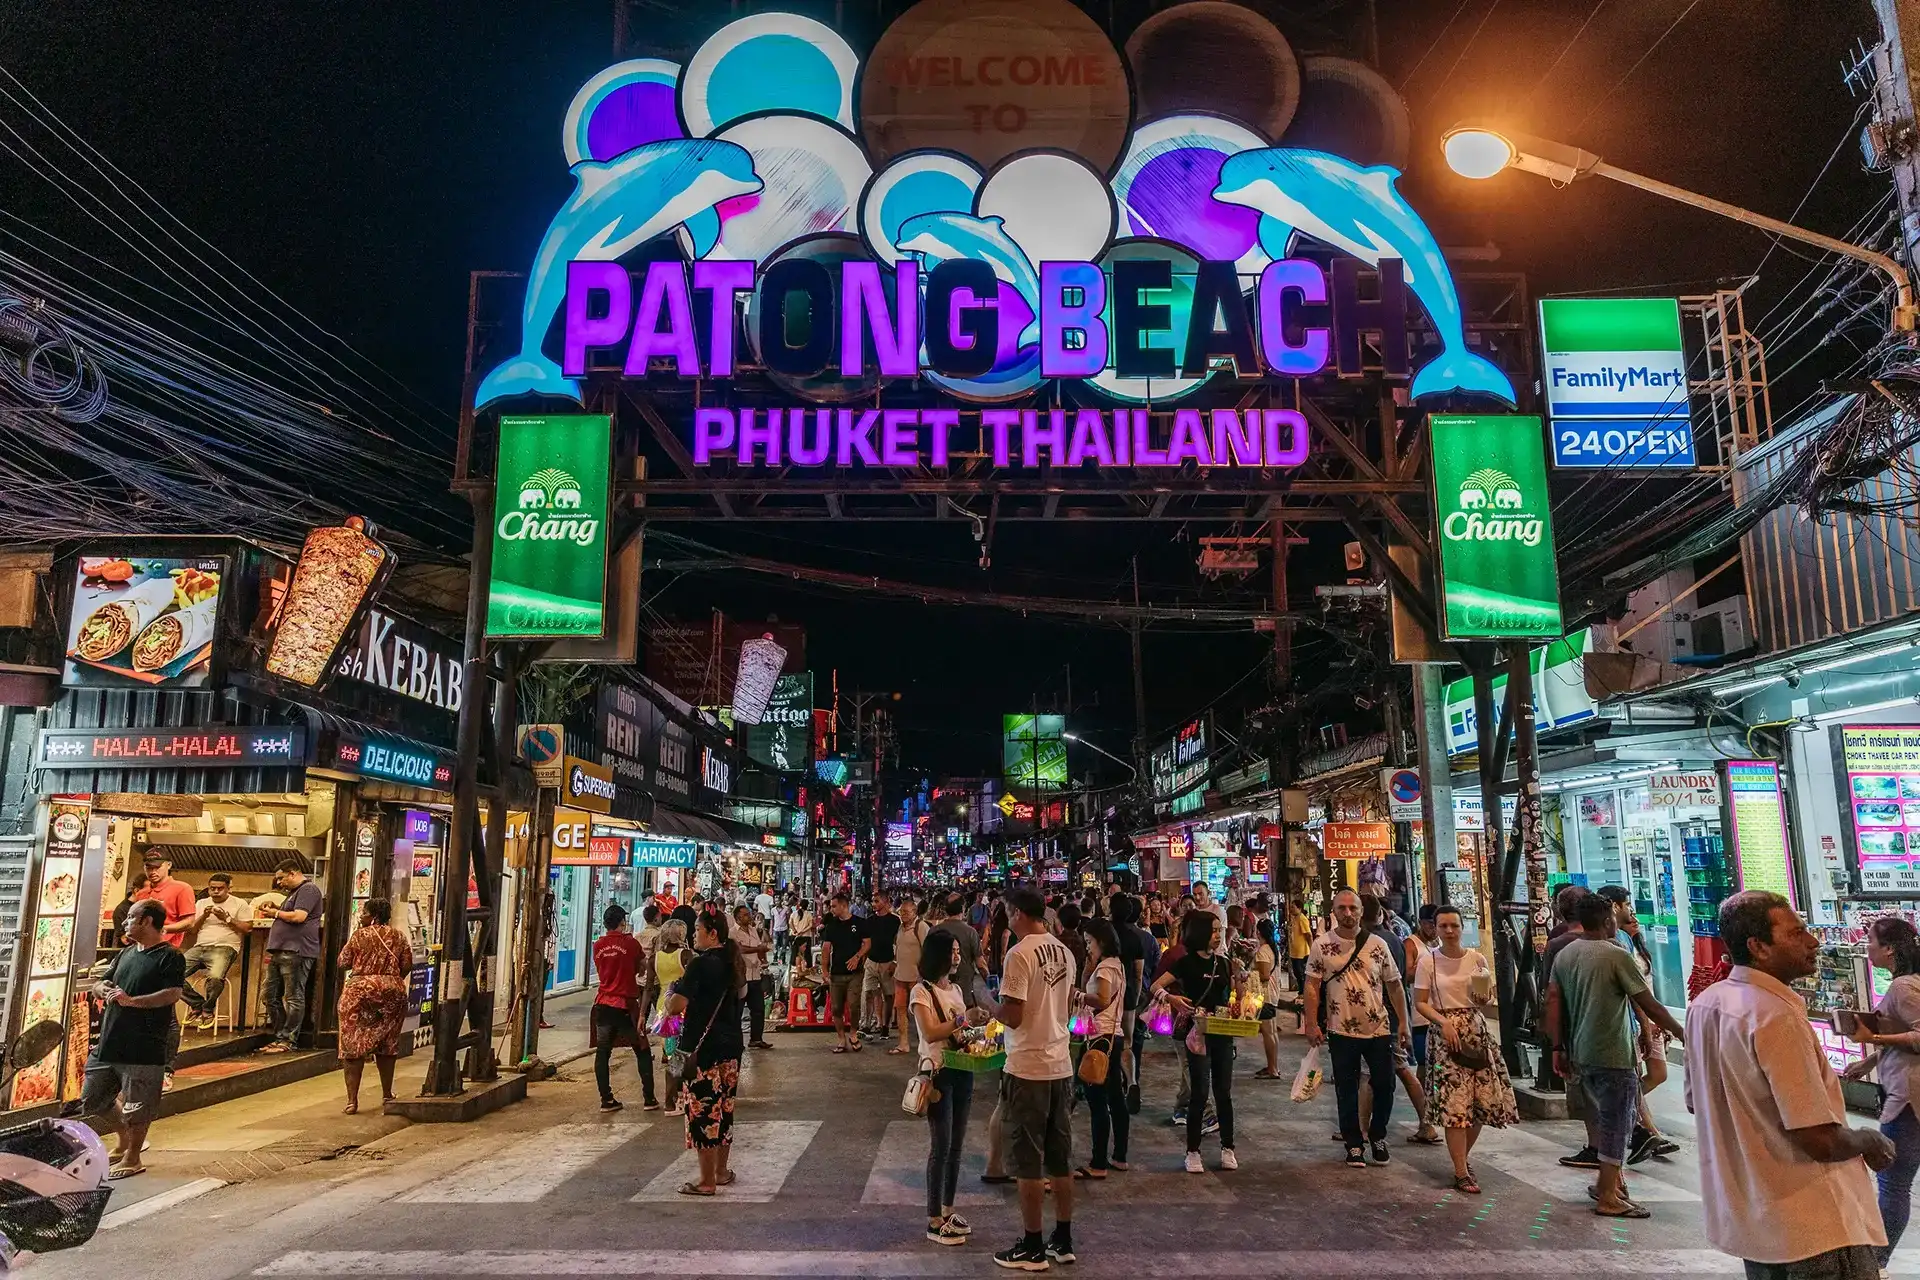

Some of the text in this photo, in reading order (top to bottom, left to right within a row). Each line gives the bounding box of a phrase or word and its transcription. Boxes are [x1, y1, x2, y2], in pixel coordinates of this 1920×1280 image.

[884, 56, 1105, 87] WELCOME
[964, 103, 1028, 134] TO
[562, 258, 1410, 380] PATONG BEACH
[1552, 366, 1683, 392] FamilyMart
[694, 408, 1311, 468] PHUKET THAILAND
[498, 511, 599, 547] Chang
[1444, 511, 1544, 547] Chang
[364, 610, 463, 712] KEBAB
[92, 736, 242, 757] HALAL-HALAL
[606, 713, 642, 759] RENT
[364, 745, 433, 781] DELICIOUS
[659, 735, 687, 774] RENT
[704, 746, 729, 794] KEBAB
[1011, 740, 1067, 775] SINGHA
[1847, 752, 1919, 760] CHOKE THAVEE CAR RENT
[1650, 775, 1718, 789] LAUNDRY
[414, 819, 428, 833] UOB
[1171, 836, 1183, 844] Oil
